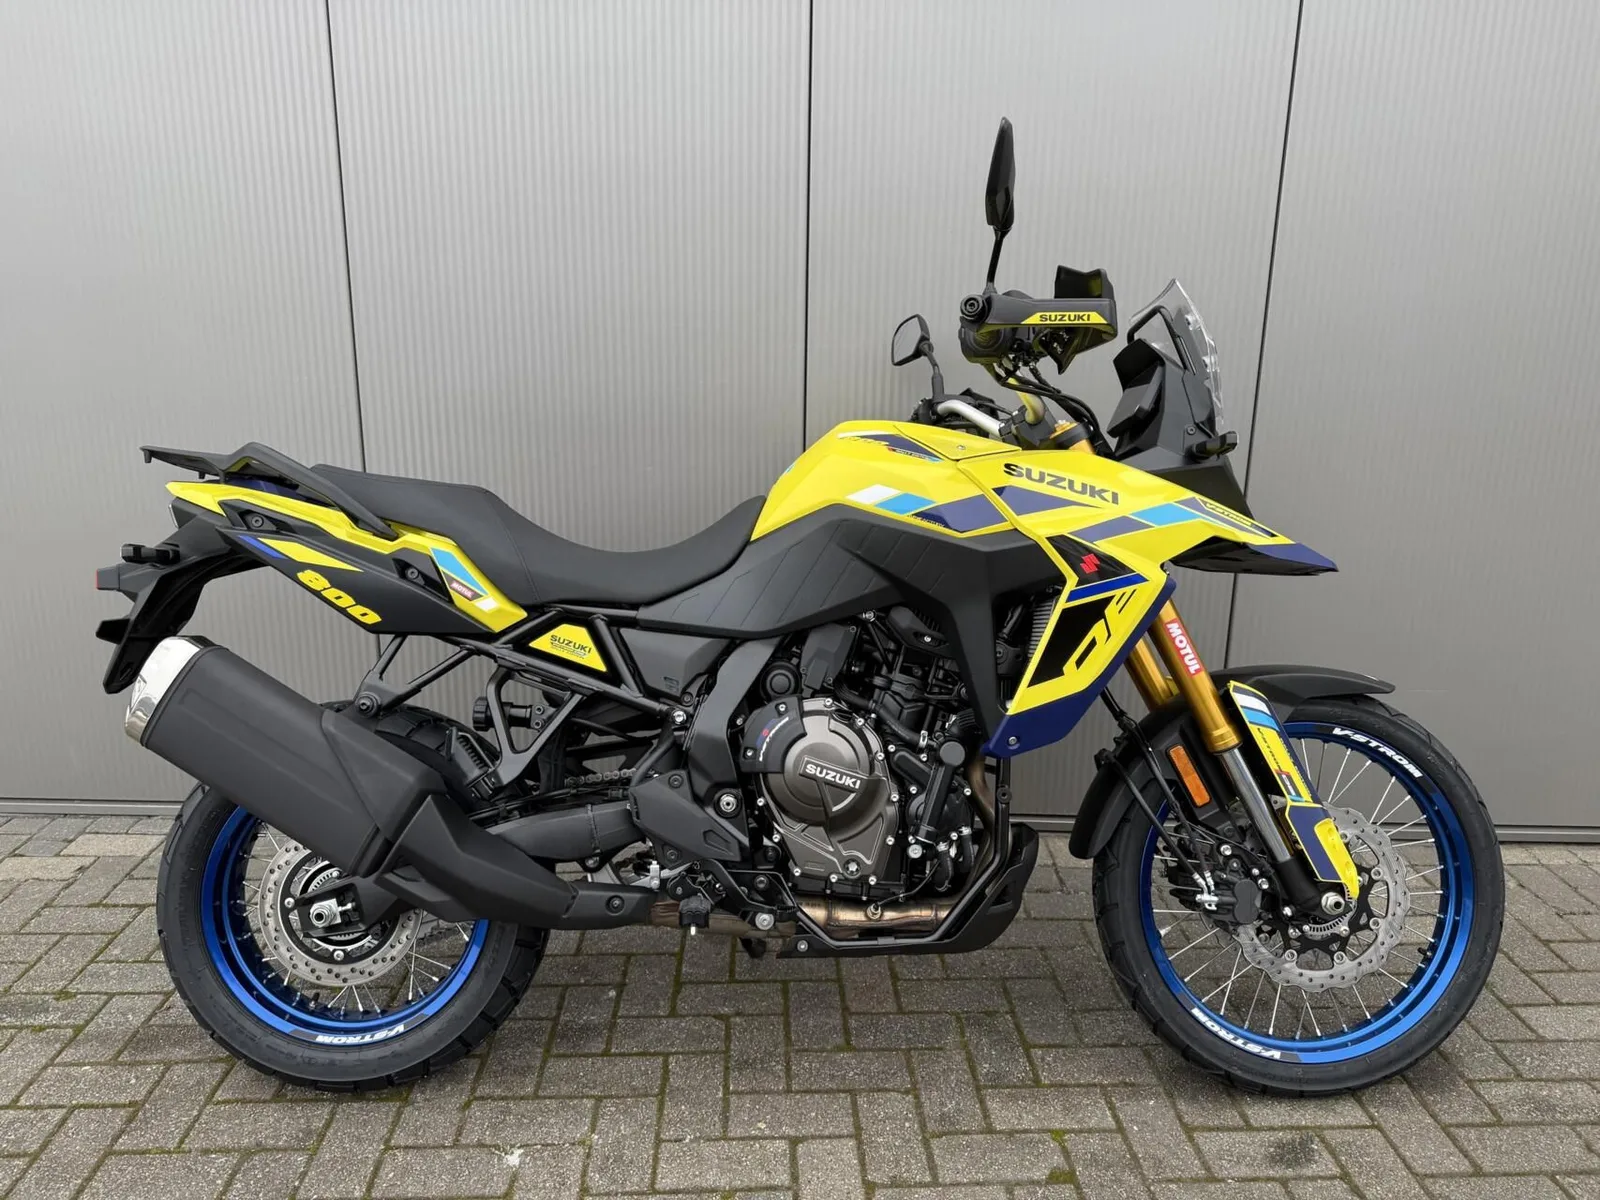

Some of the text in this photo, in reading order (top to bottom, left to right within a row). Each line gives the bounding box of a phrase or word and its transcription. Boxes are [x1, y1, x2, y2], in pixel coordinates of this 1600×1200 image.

[1039, 313, 1092, 323] SUZUKI
[1003, 462, 1119, 506] SUZUKI
[296, 569, 382, 625] 800
[450, 580, 476, 600] MOTUL
[550, 634, 592, 654] SUZUKI
[1165, 622, 1201, 675] MOTUL
[1332, 727, 1424, 778] V-STROM
[805, 763, 861, 790] SUZUKI
[315, 1024, 405, 1044] V-STROM
[1191, 1007, 1281, 1060] V-STROM
